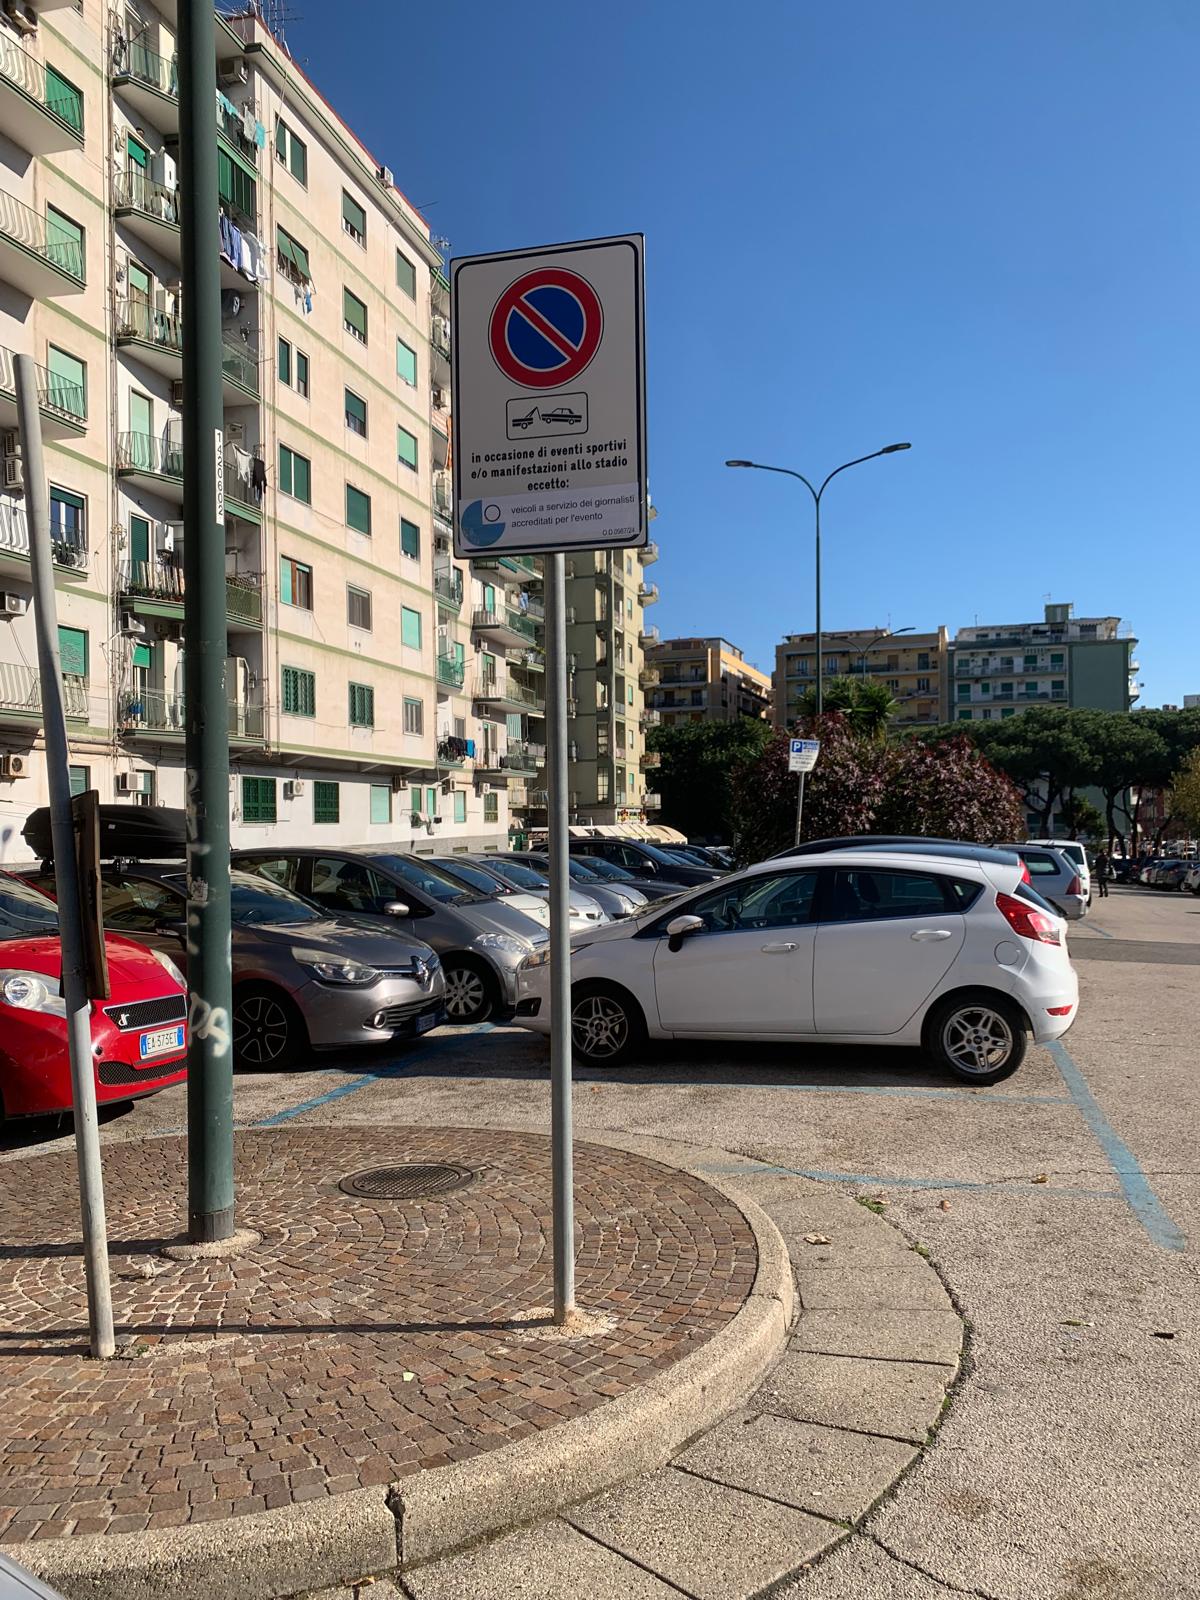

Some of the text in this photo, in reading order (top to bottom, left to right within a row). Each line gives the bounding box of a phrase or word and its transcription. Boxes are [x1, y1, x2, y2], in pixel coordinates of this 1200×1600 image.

[472, 439, 627, 463] in occasione di eventi sportivi
[471, 457, 627, 479] e/o manifestazioni allo stadio
[528, 479, 569, 491] eccetto:
[511, 503, 536, 514] veicoli
[547, 501, 578, 511] servizio
[580, 498, 592, 507] dei
[595, 496, 635, 509] giornalisti
[512, 513, 602, 527] accreditati per l'evento
[793, 741, 802, 752] P
